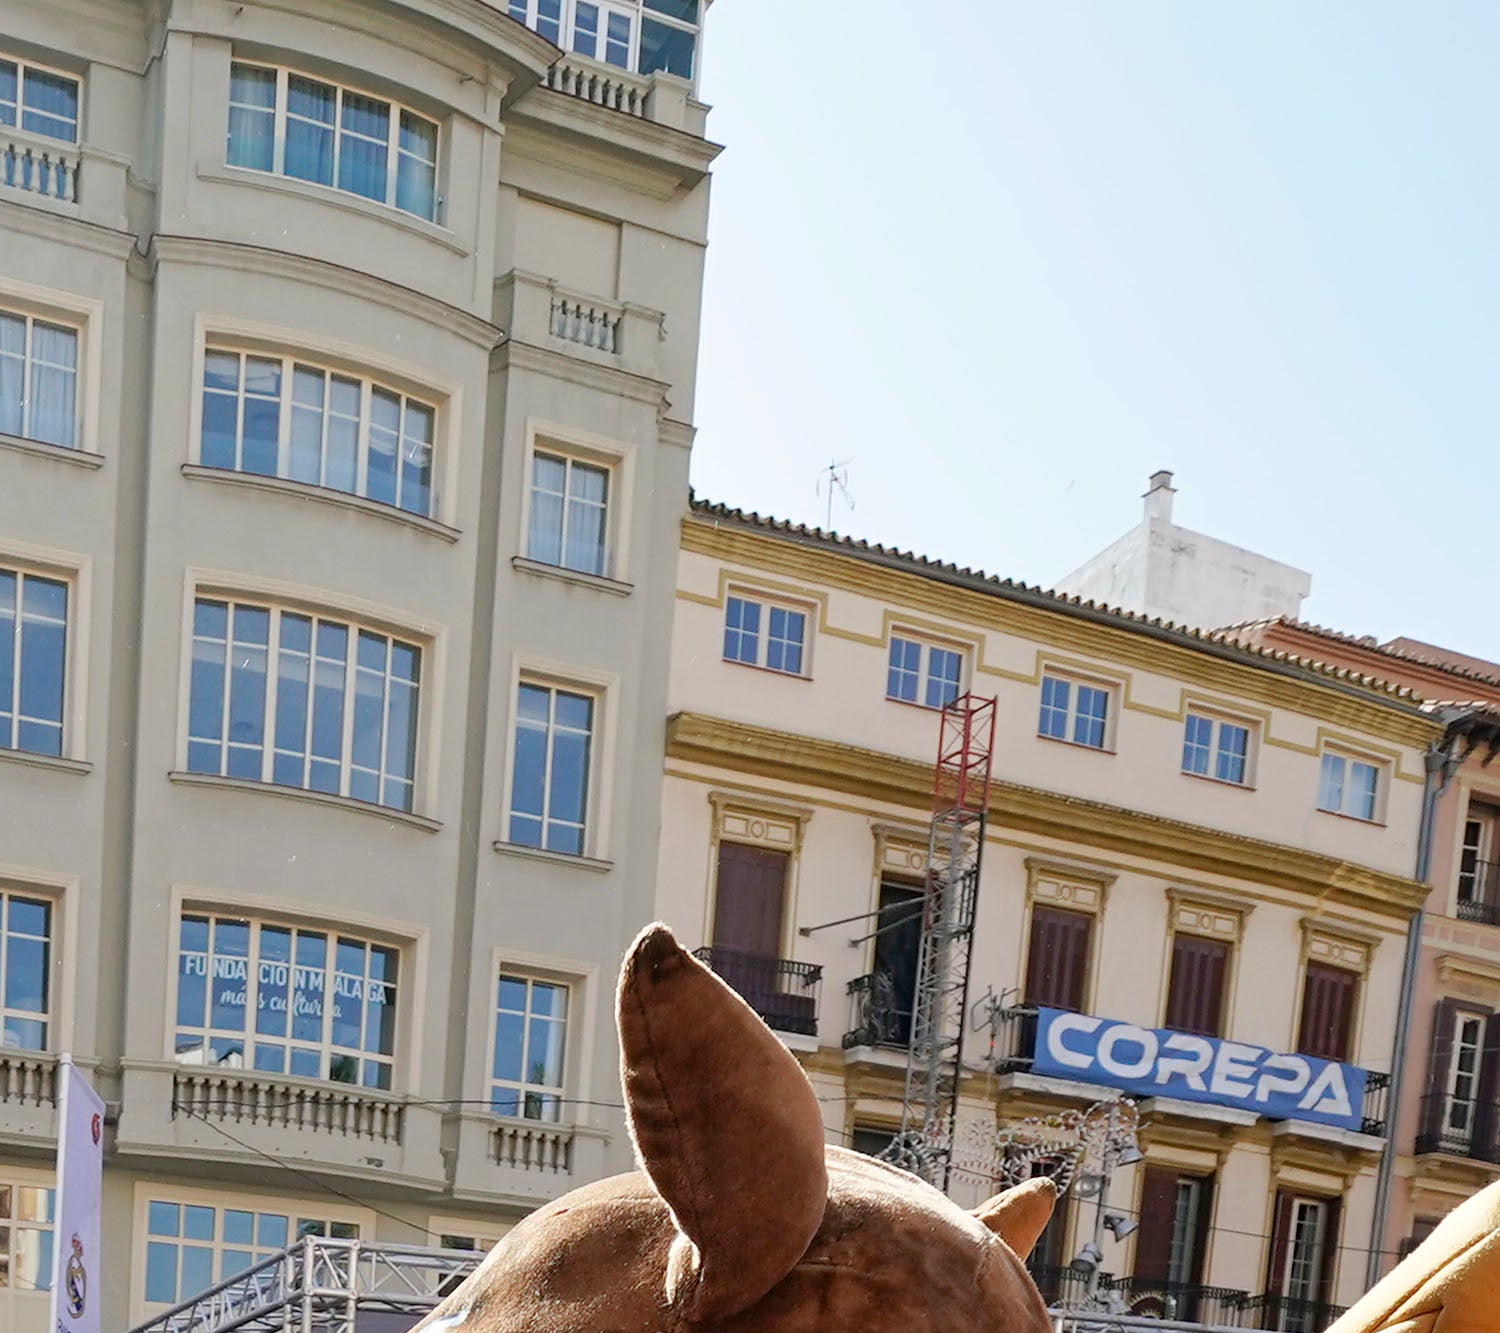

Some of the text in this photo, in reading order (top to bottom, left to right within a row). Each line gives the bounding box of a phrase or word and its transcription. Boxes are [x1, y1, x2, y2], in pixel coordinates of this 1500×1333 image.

[185, 955, 388, 1005] FUNDACIÓN MÁLAGA
[1047, 1012, 1353, 1117] COREPA
